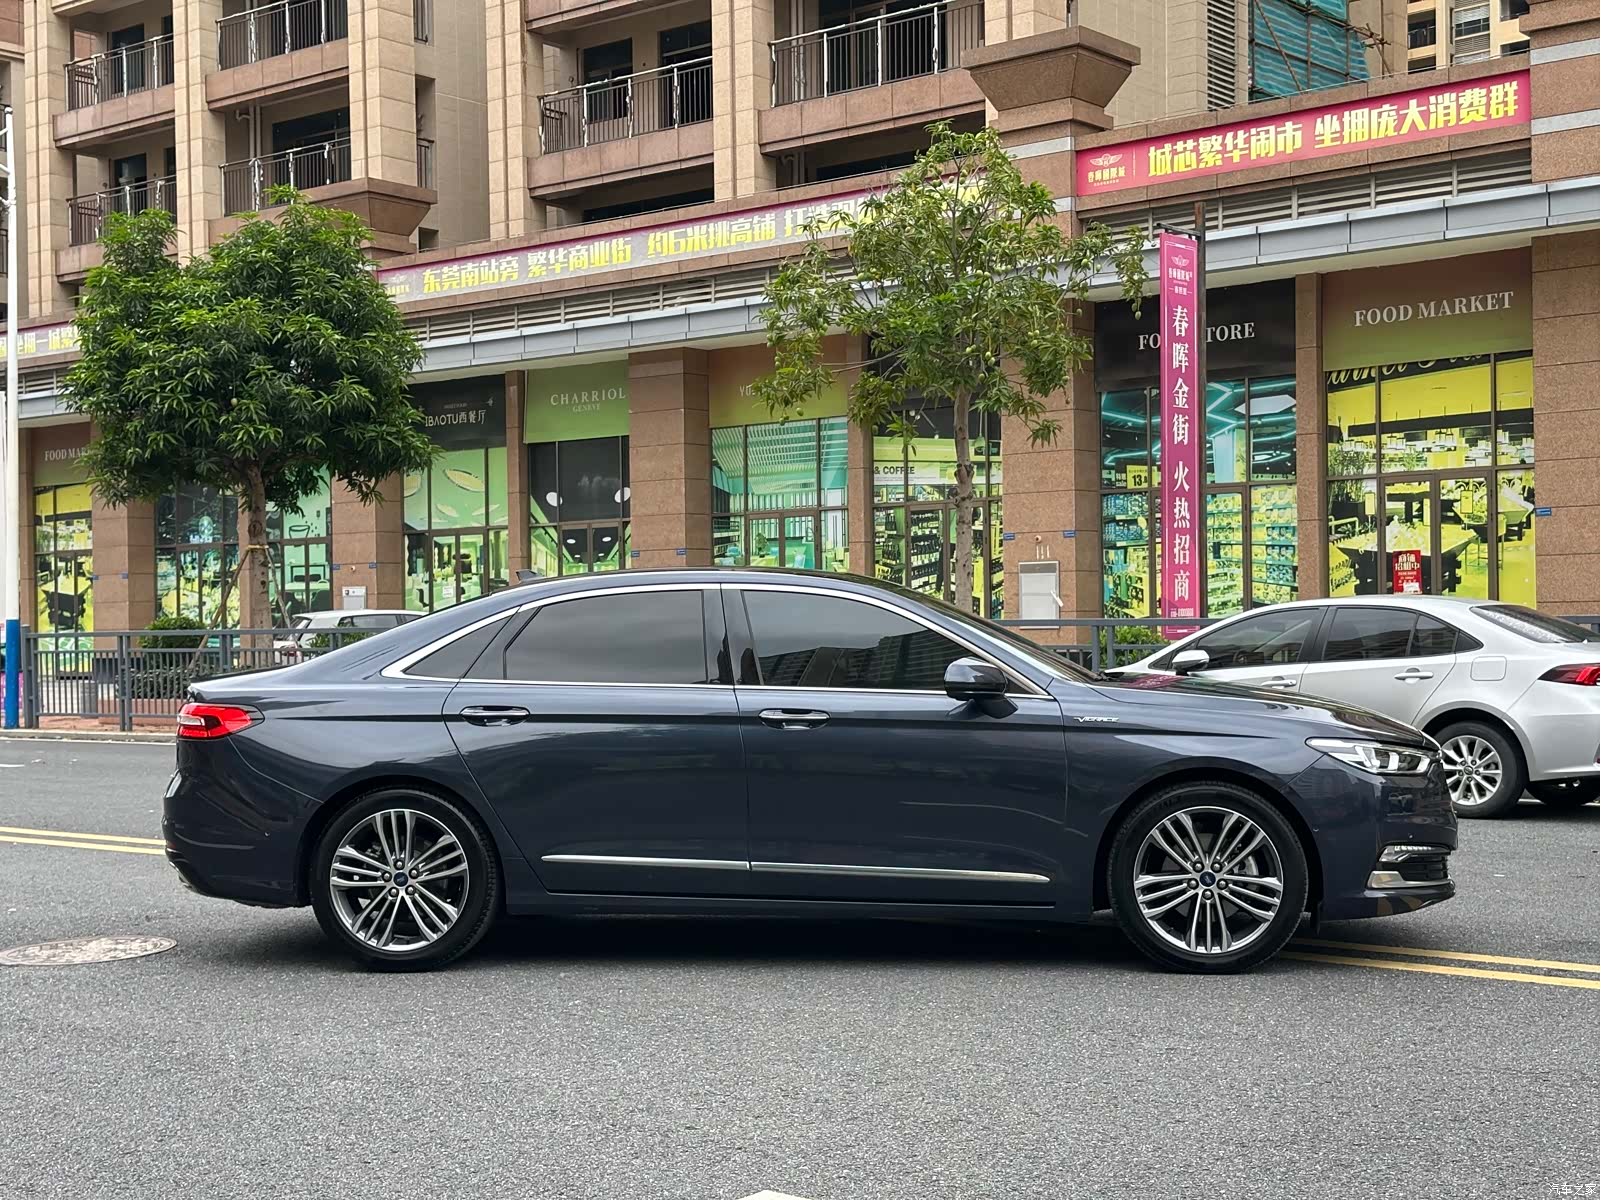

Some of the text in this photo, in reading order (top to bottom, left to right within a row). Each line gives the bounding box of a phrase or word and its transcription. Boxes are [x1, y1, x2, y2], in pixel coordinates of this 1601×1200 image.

[1148, 80, 1519, 176] 城芯繁华闹市 坐拥庞大消费群
[422, 255, 519, 294] 东莞南站旁
[527, 236, 632, 279] 繁华商业街
[647, 212, 776, 258] 约6米挑高铺
[1138, 322, 1255, 350] FO TORE
[1354, 291, 1514, 327] FOOD MARKET
[550, 387, 626, 406] CHARRIOL
[1172, 304, 1189, 446] 春晖金街
[44, 449, 67, 461] FOOD
[1173, 460, 1190, 602] 火热招商
